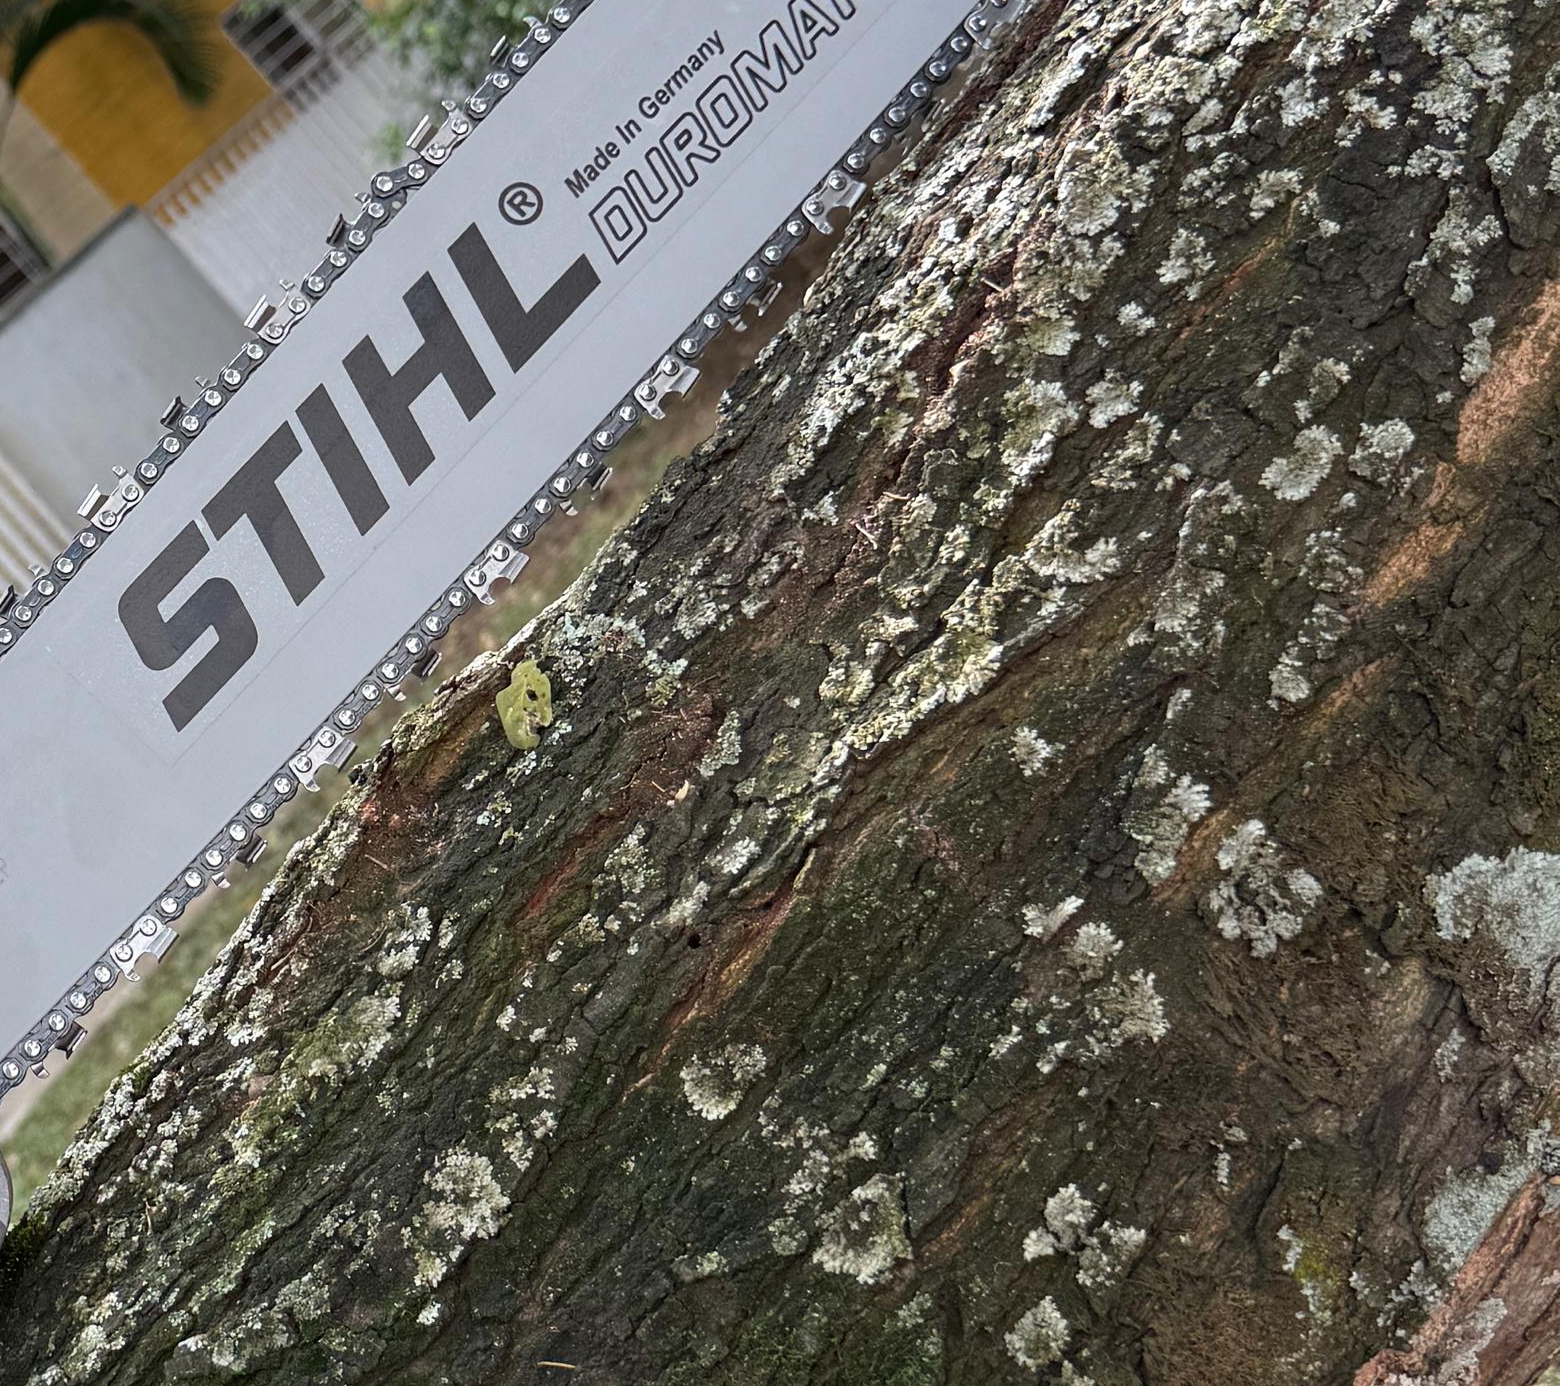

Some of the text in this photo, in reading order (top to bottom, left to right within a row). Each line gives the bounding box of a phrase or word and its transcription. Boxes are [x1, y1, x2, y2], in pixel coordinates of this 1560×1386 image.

[564, 30, 726, 198] Made In Germany
